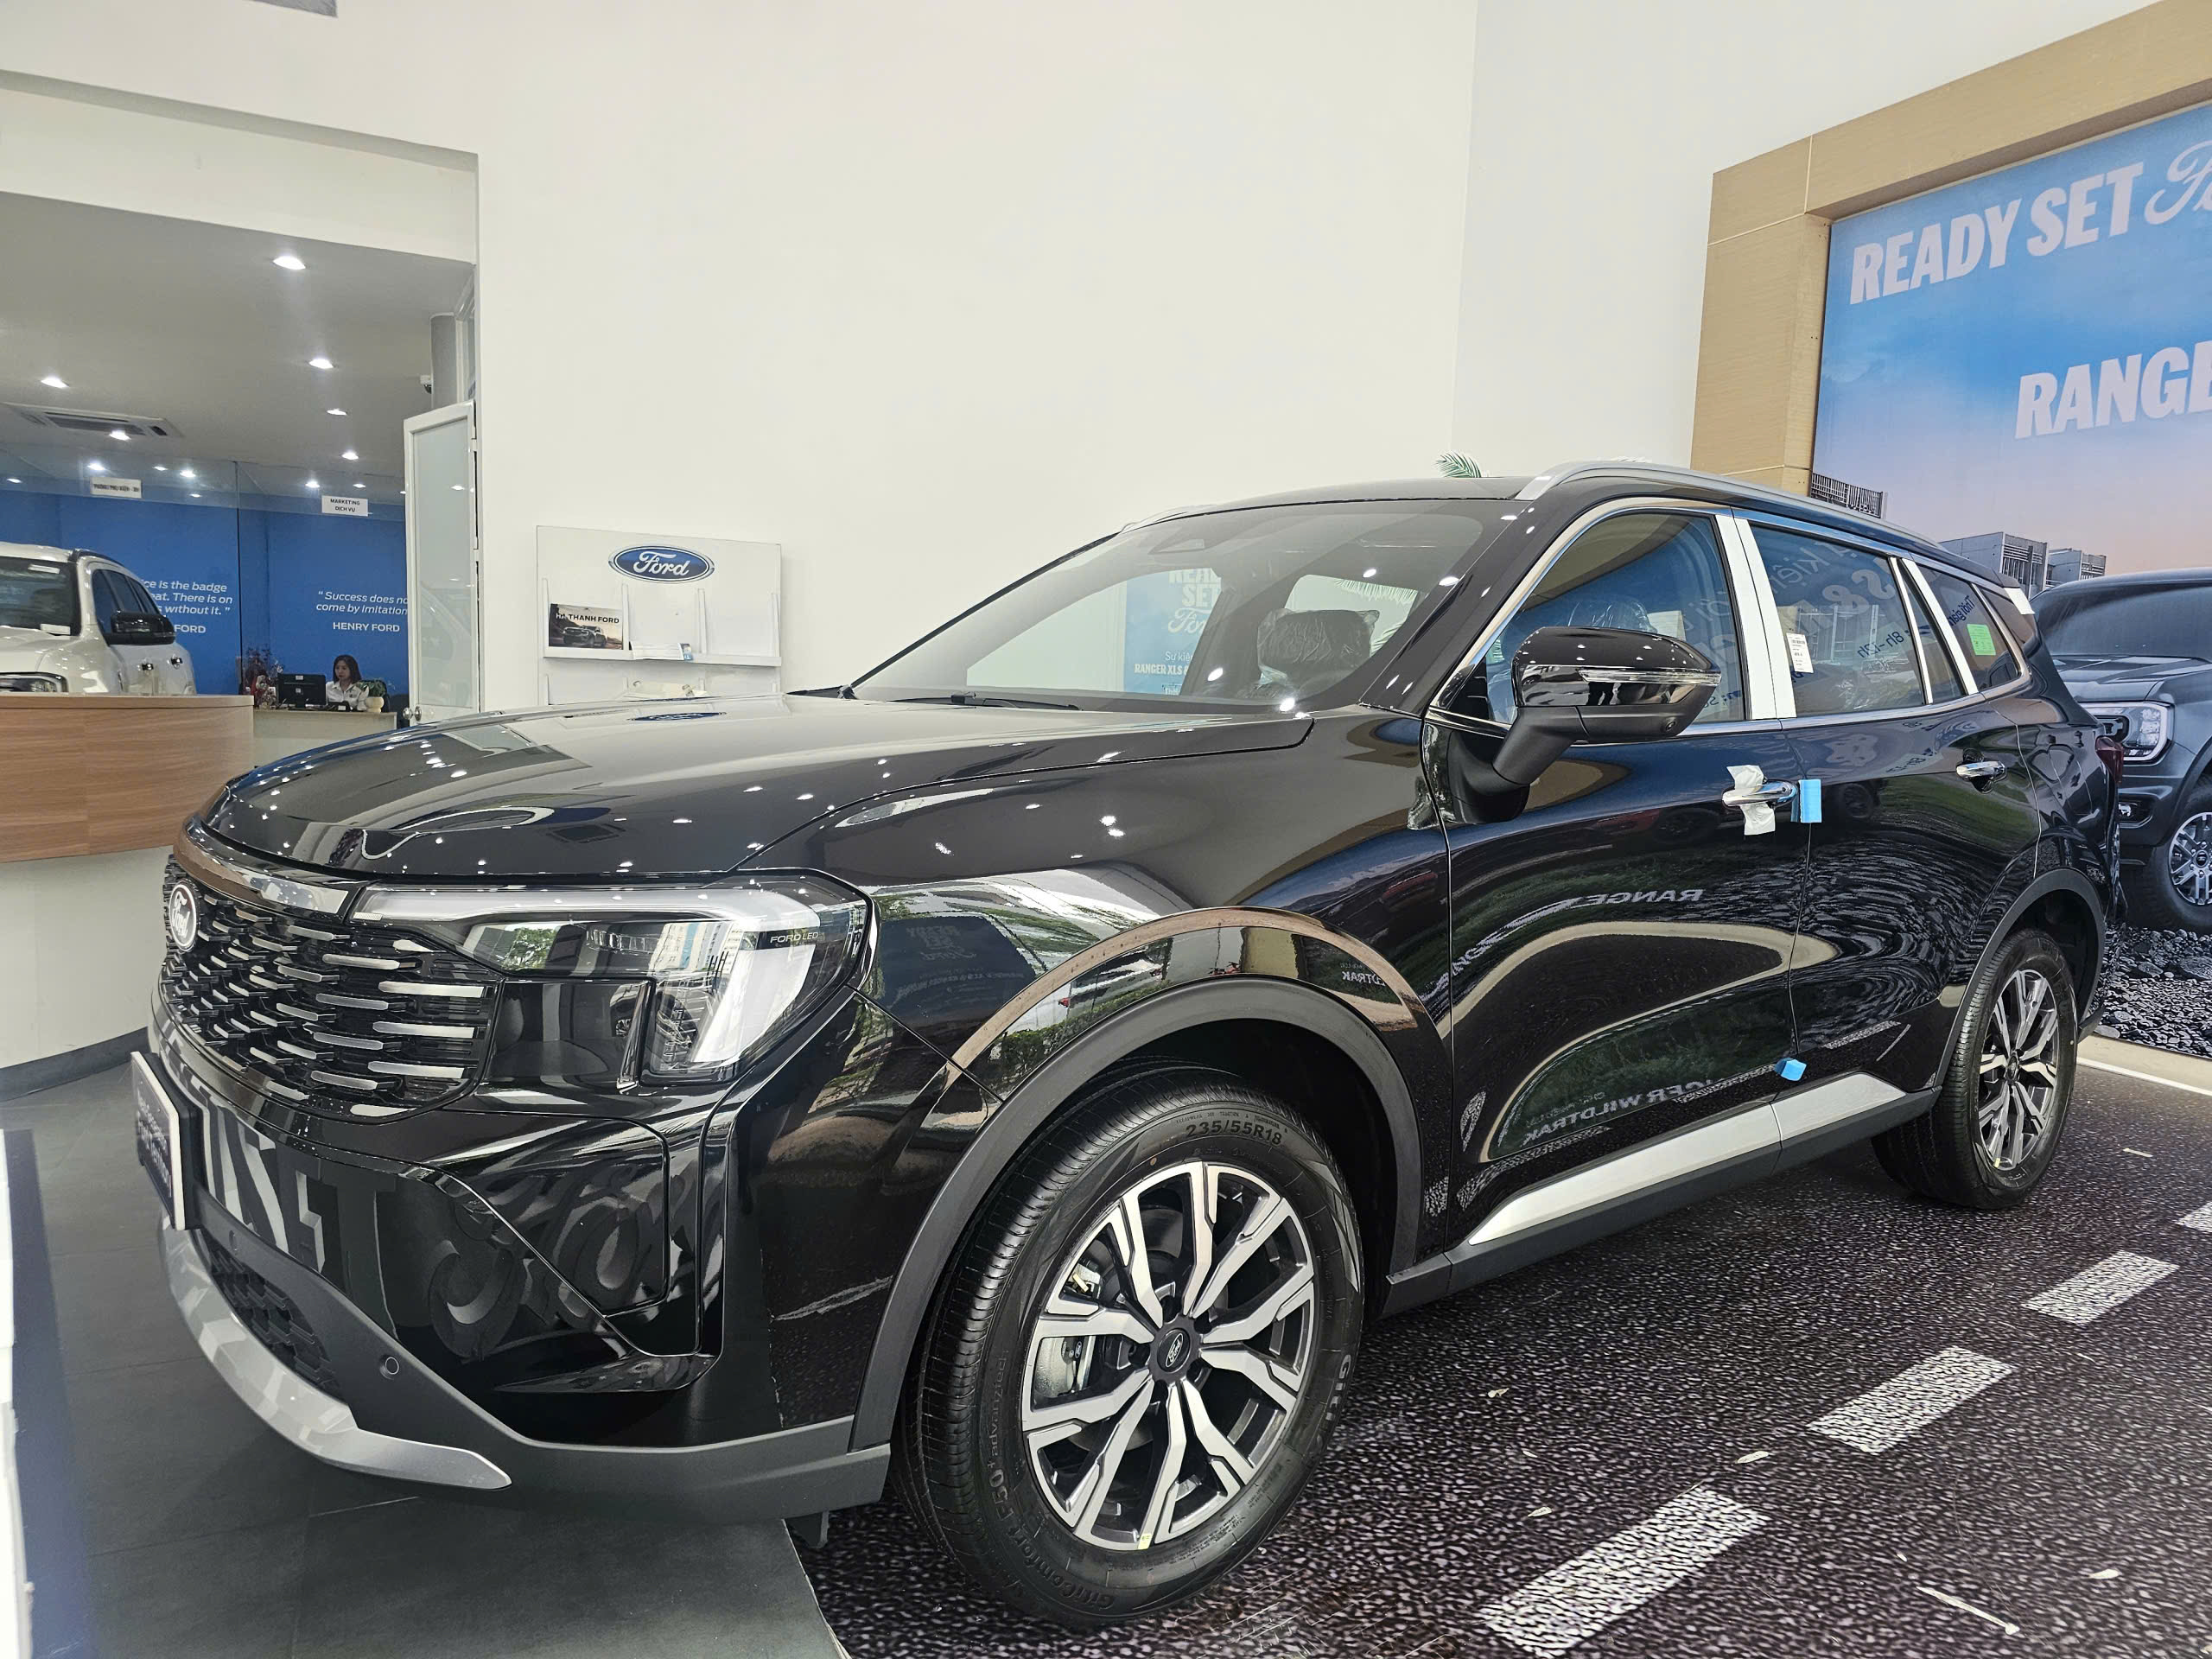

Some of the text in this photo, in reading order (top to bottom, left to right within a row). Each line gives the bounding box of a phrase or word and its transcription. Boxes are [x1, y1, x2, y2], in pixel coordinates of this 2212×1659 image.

[1850, 199, 2022, 305] READY
[2026, 162, 2144, 257] SET
[632, 550, 690, 577] Ford
[158, 580, 168, 588] is
[171, 581, 189, 590] the
[192, 582, 228, 594] badge
[172, 592, 206, 602] There
[207, 594, 217, 603] is
[324, 591, 368, 602] Success
[369, 594, 395, 604] does
[165, 605, 209, 614] without
[315, 603, 346, 612] come
[346, 604, 360, 614] by
[568, 613, 596, 622] THANH
[174, 624, 207, 633] FORD
[333, 621, 400, 632] HENRY FORD
[1134, 664, 1167, 675] RANGER
[1167, 664, 1183, 675] XLS
[770, 931, 819, 944] FORD LED
[1185, 1119, 1283, 1146] 235/55R18
